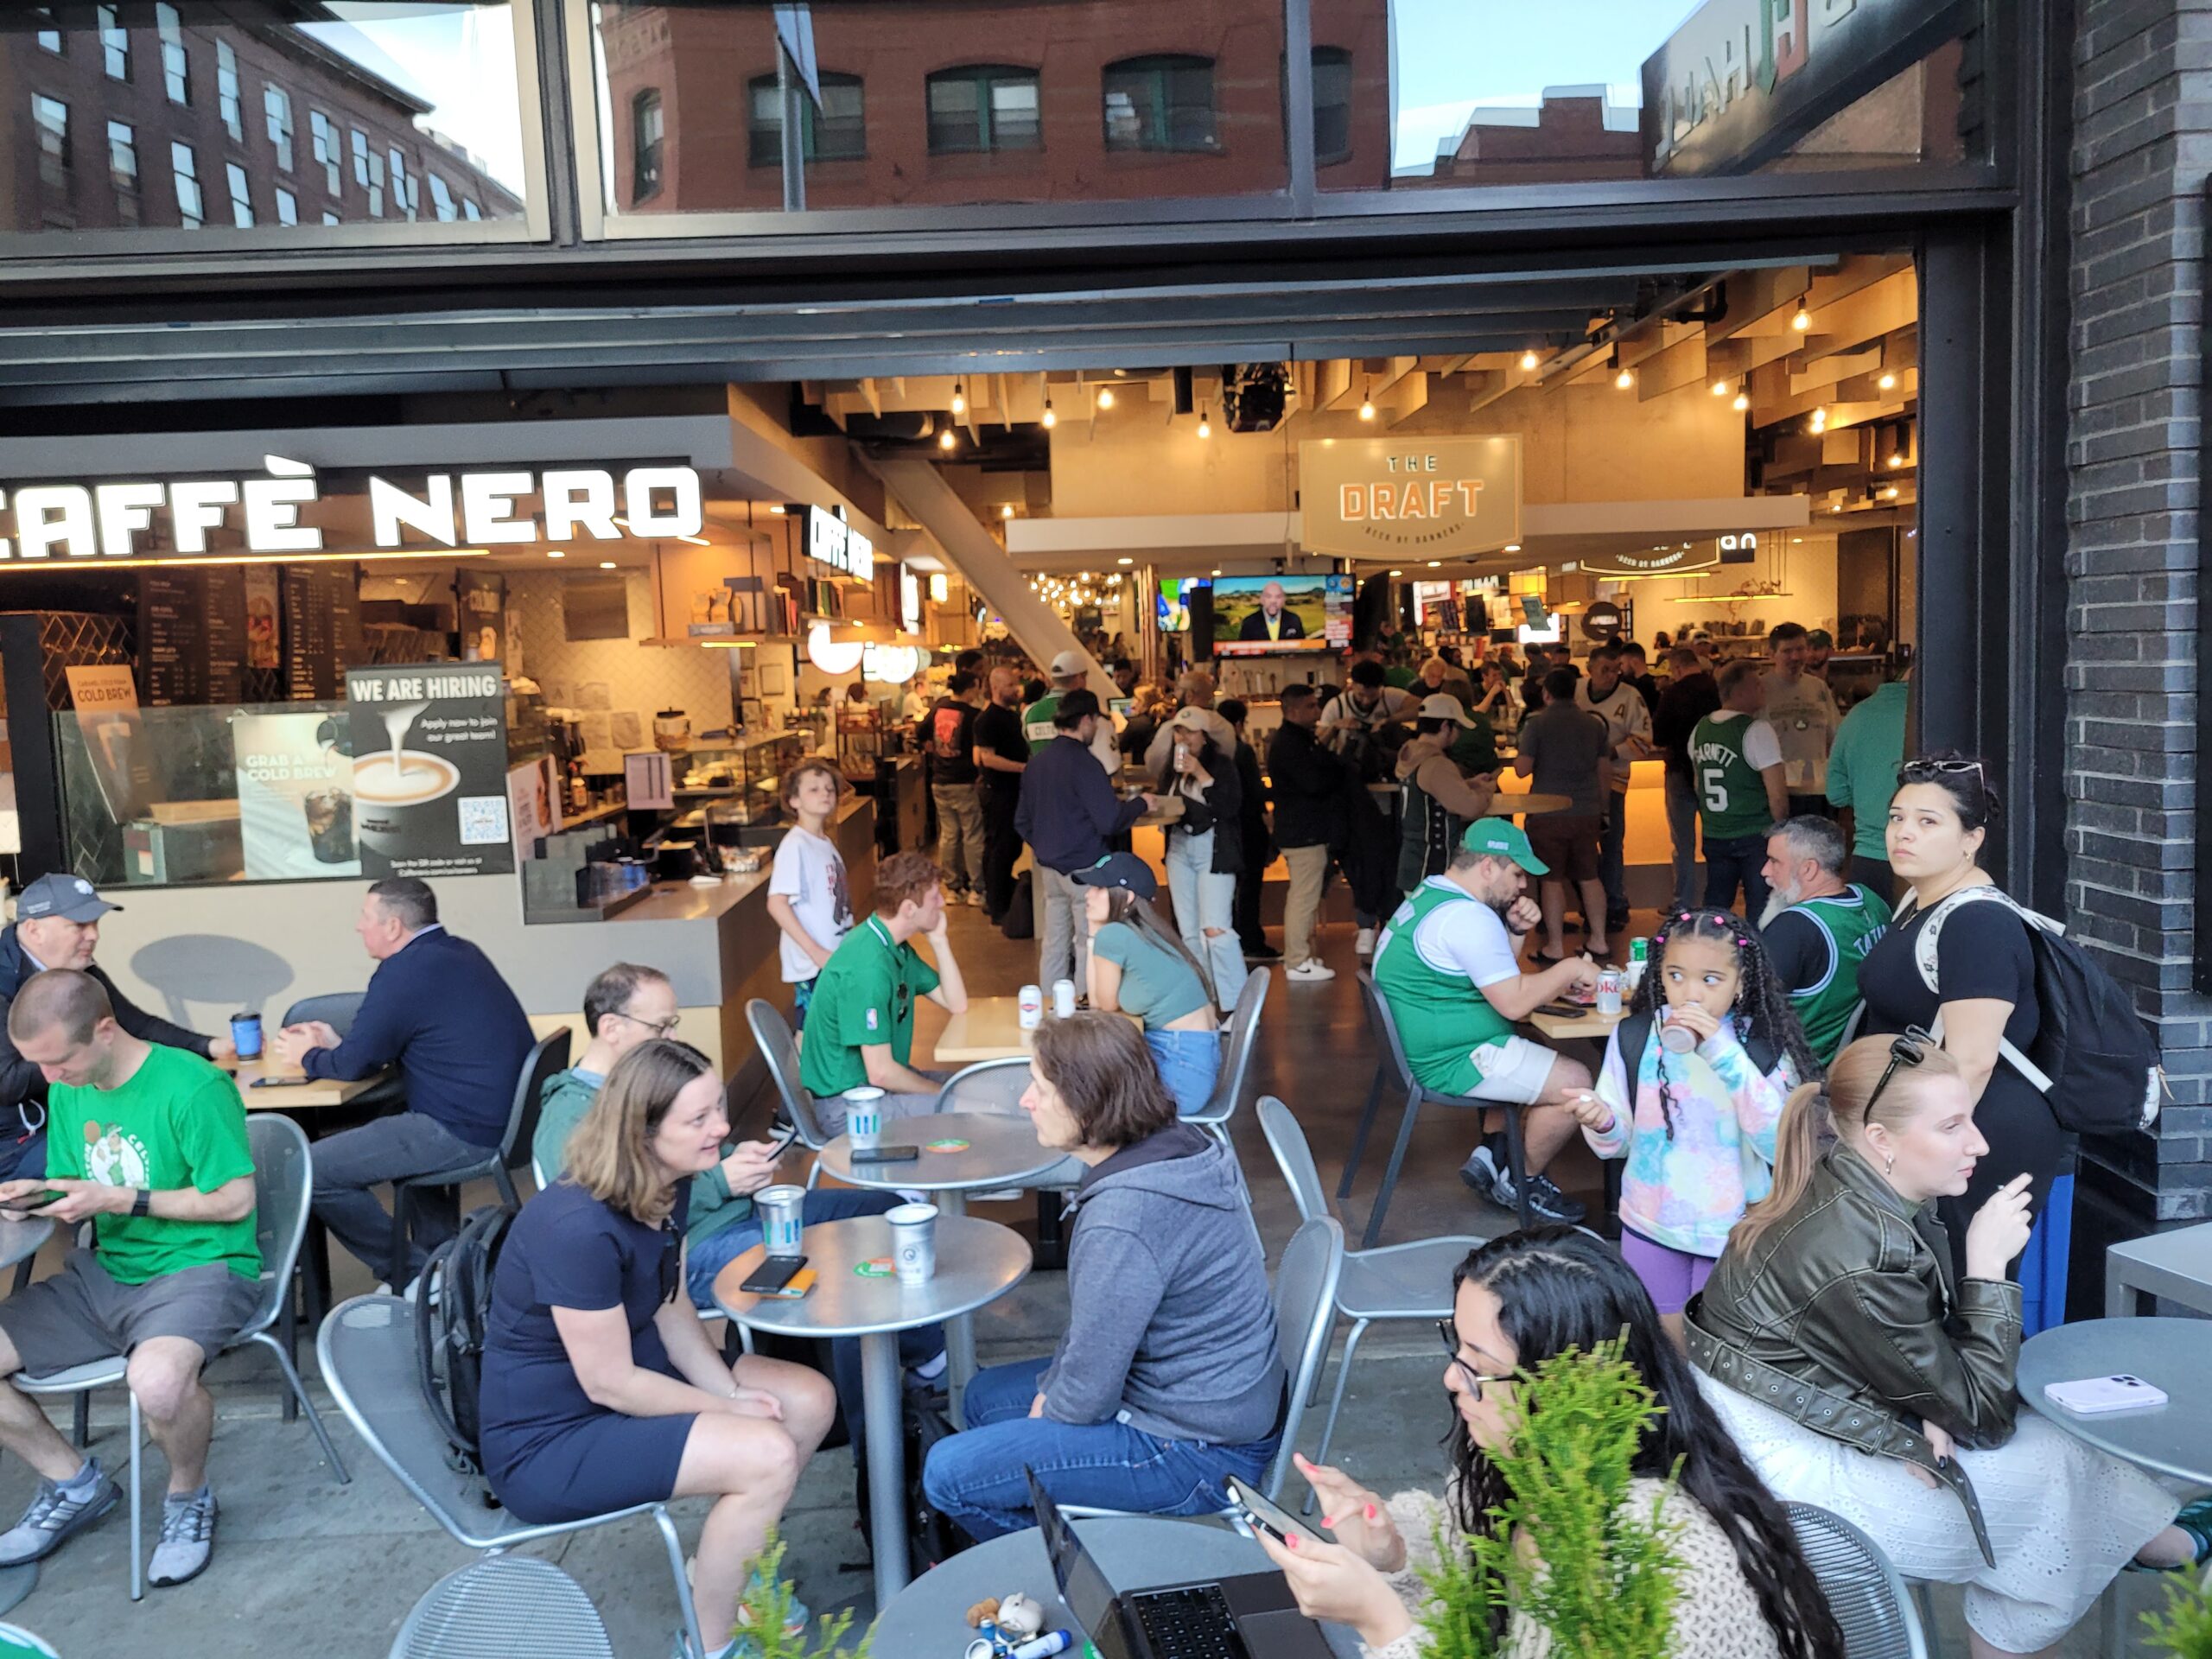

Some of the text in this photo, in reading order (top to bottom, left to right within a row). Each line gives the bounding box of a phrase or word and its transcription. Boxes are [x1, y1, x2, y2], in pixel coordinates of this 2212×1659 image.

[1387, 454, 1438, 473] THE
[0, 453, 703, 559] AFFÈ NERO
[1340, 480, 1484, 521] DRAFT
[78, 687, 131, 702] COLD BREW
[352, 675, 497, 702] WE ARE HIRING
[245, 753, 303, 768] GRAB A
[247, 766, 338, 782] COLD BREW
[1703, 768, 1728, 812] 5
